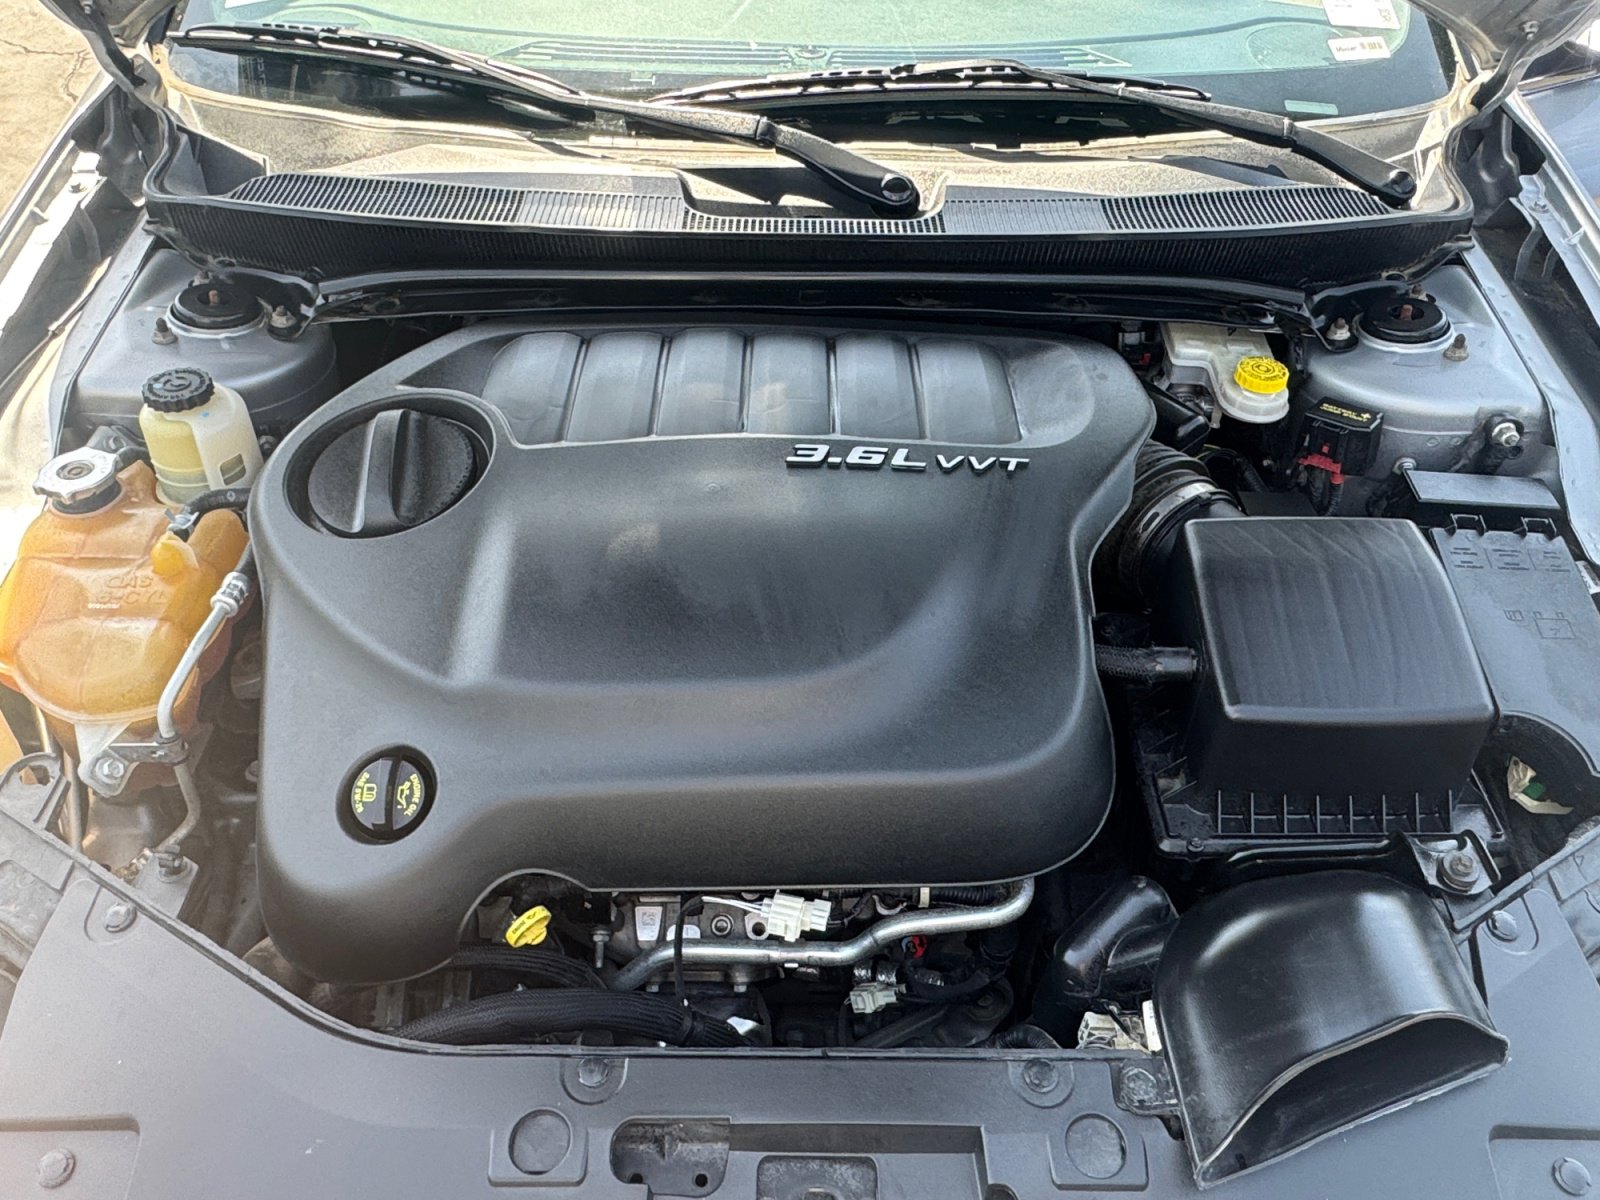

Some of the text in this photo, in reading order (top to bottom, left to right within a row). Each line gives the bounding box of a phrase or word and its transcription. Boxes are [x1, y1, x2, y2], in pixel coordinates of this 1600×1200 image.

[786, 443, 1030, 474] 3.6L VVT
[404, 774, 421, 816] ENGINE OIL
